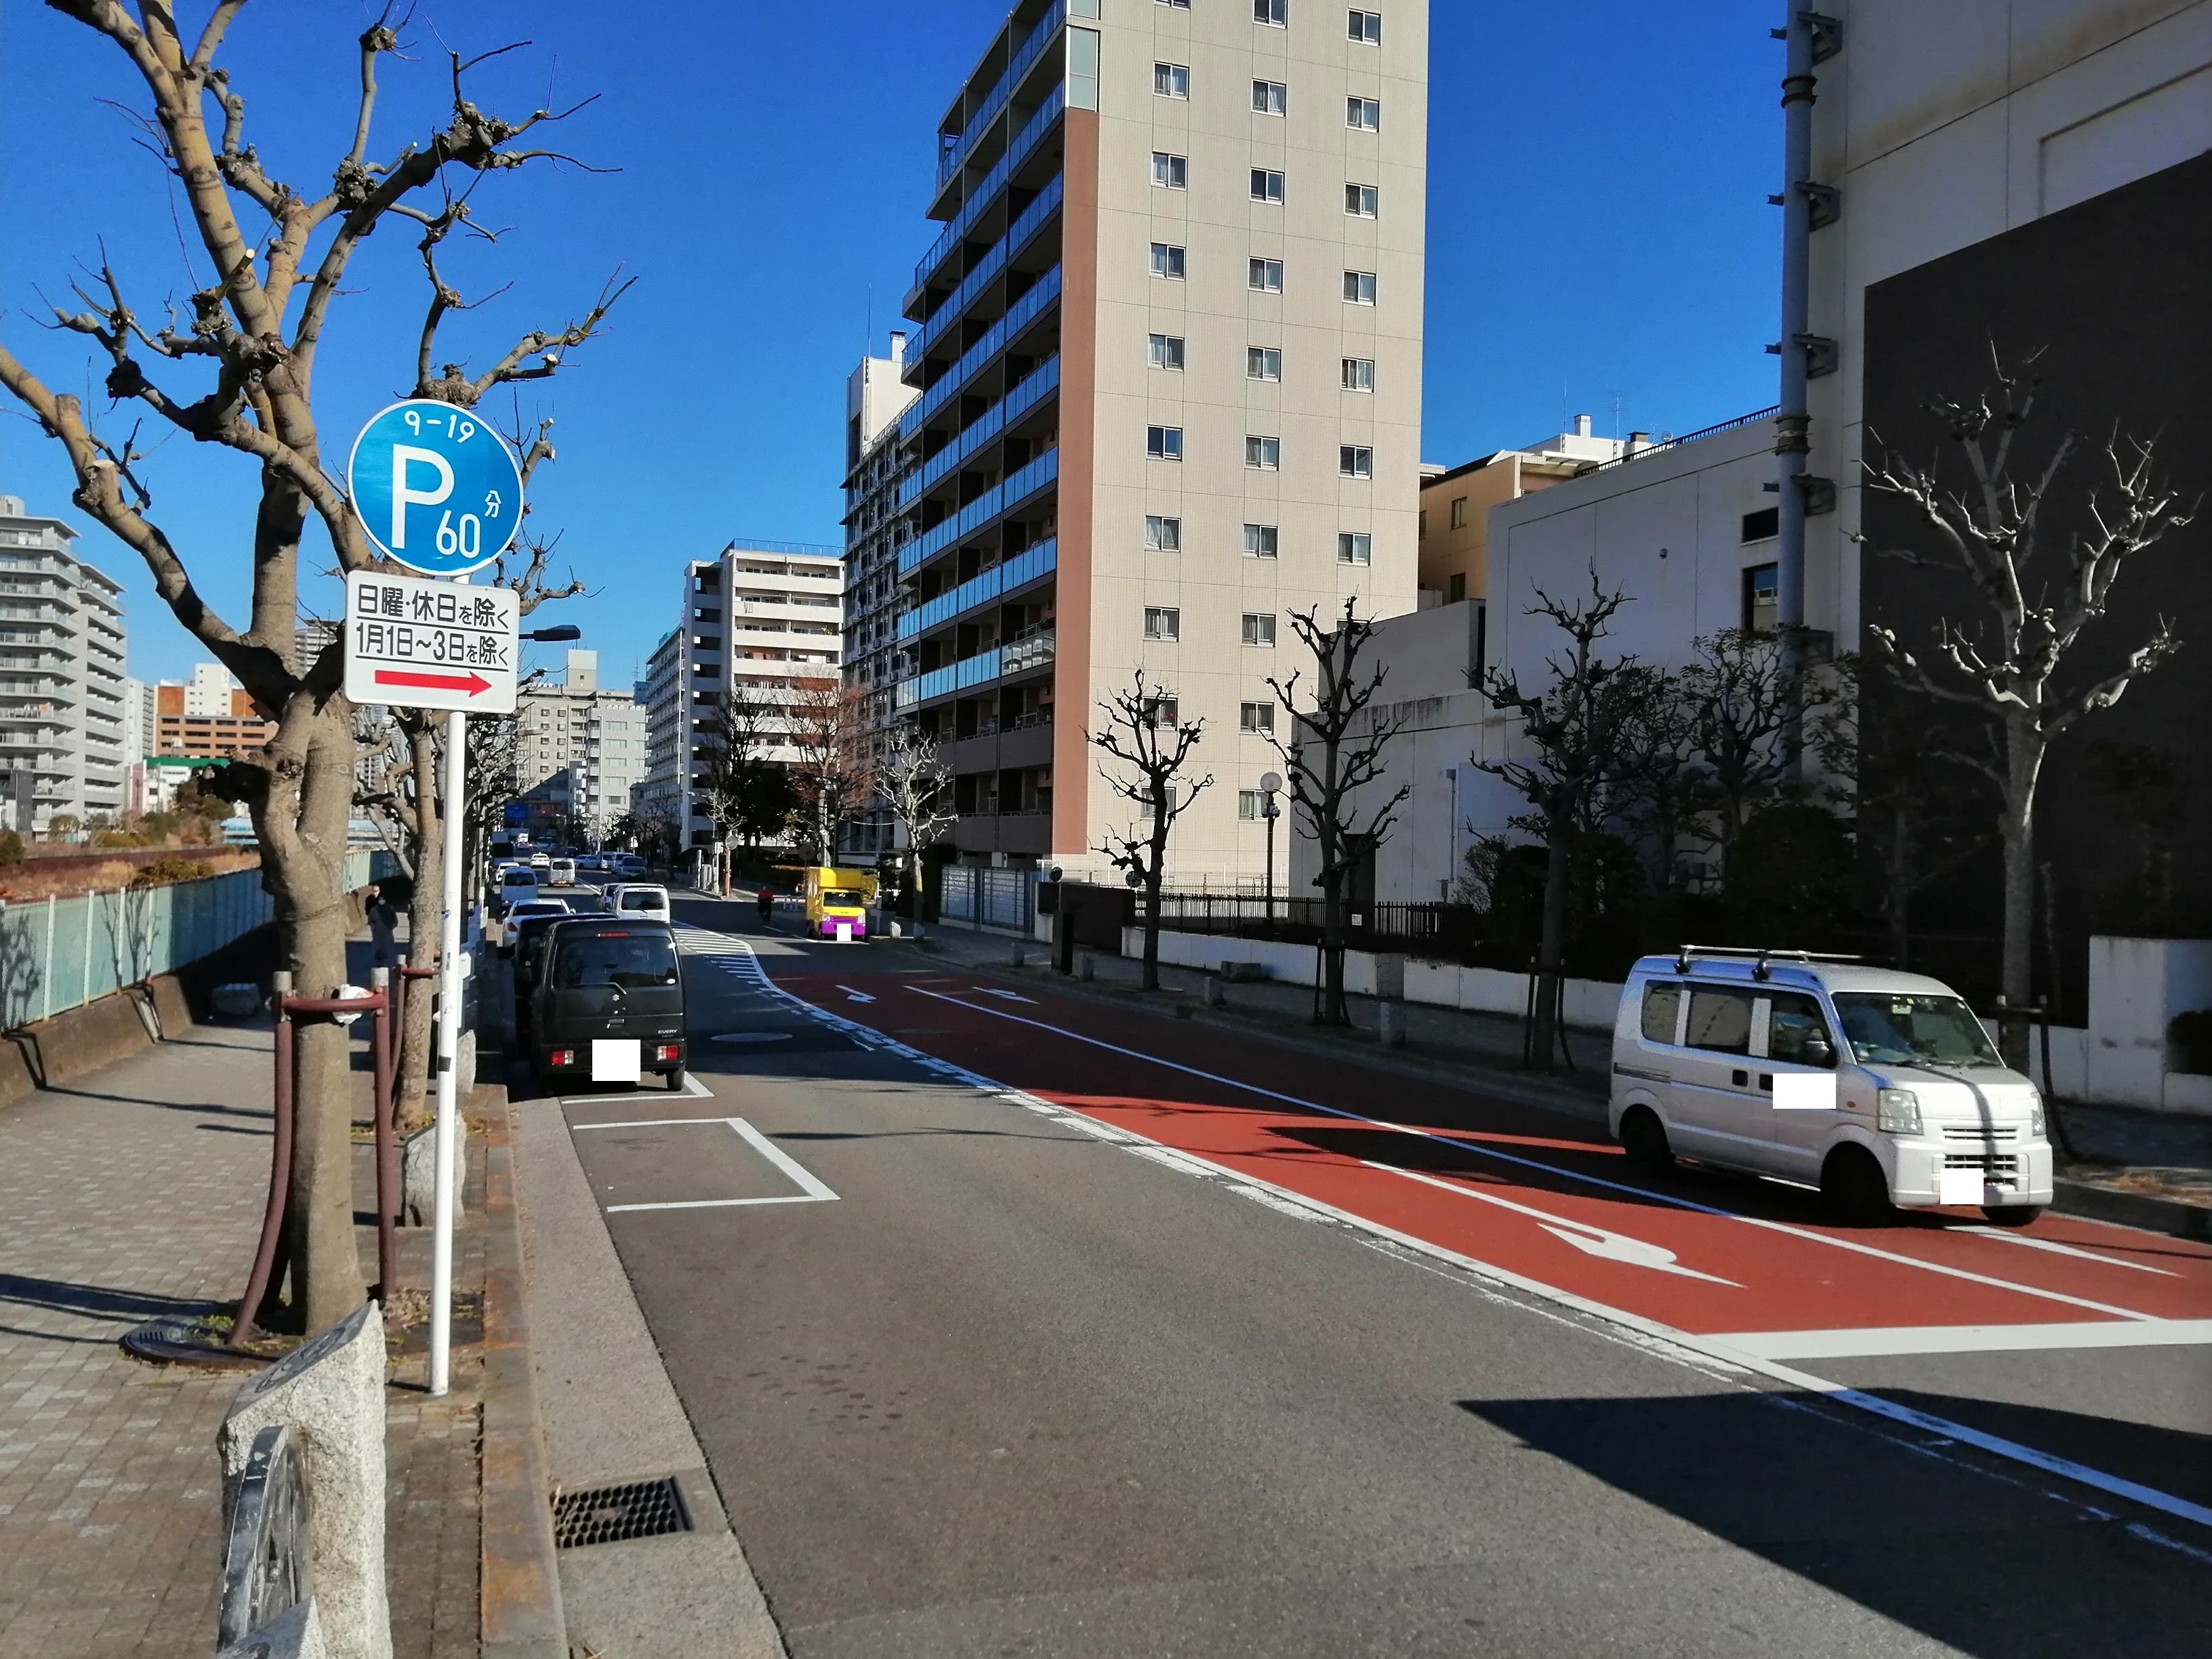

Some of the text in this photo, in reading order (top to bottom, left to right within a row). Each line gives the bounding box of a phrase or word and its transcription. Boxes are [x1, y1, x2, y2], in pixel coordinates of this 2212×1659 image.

[404, 410, 475, 444] 9-19
[391, 443, 455, 550] P
[358, 583, 509, 629] 日曜・休日を除く
